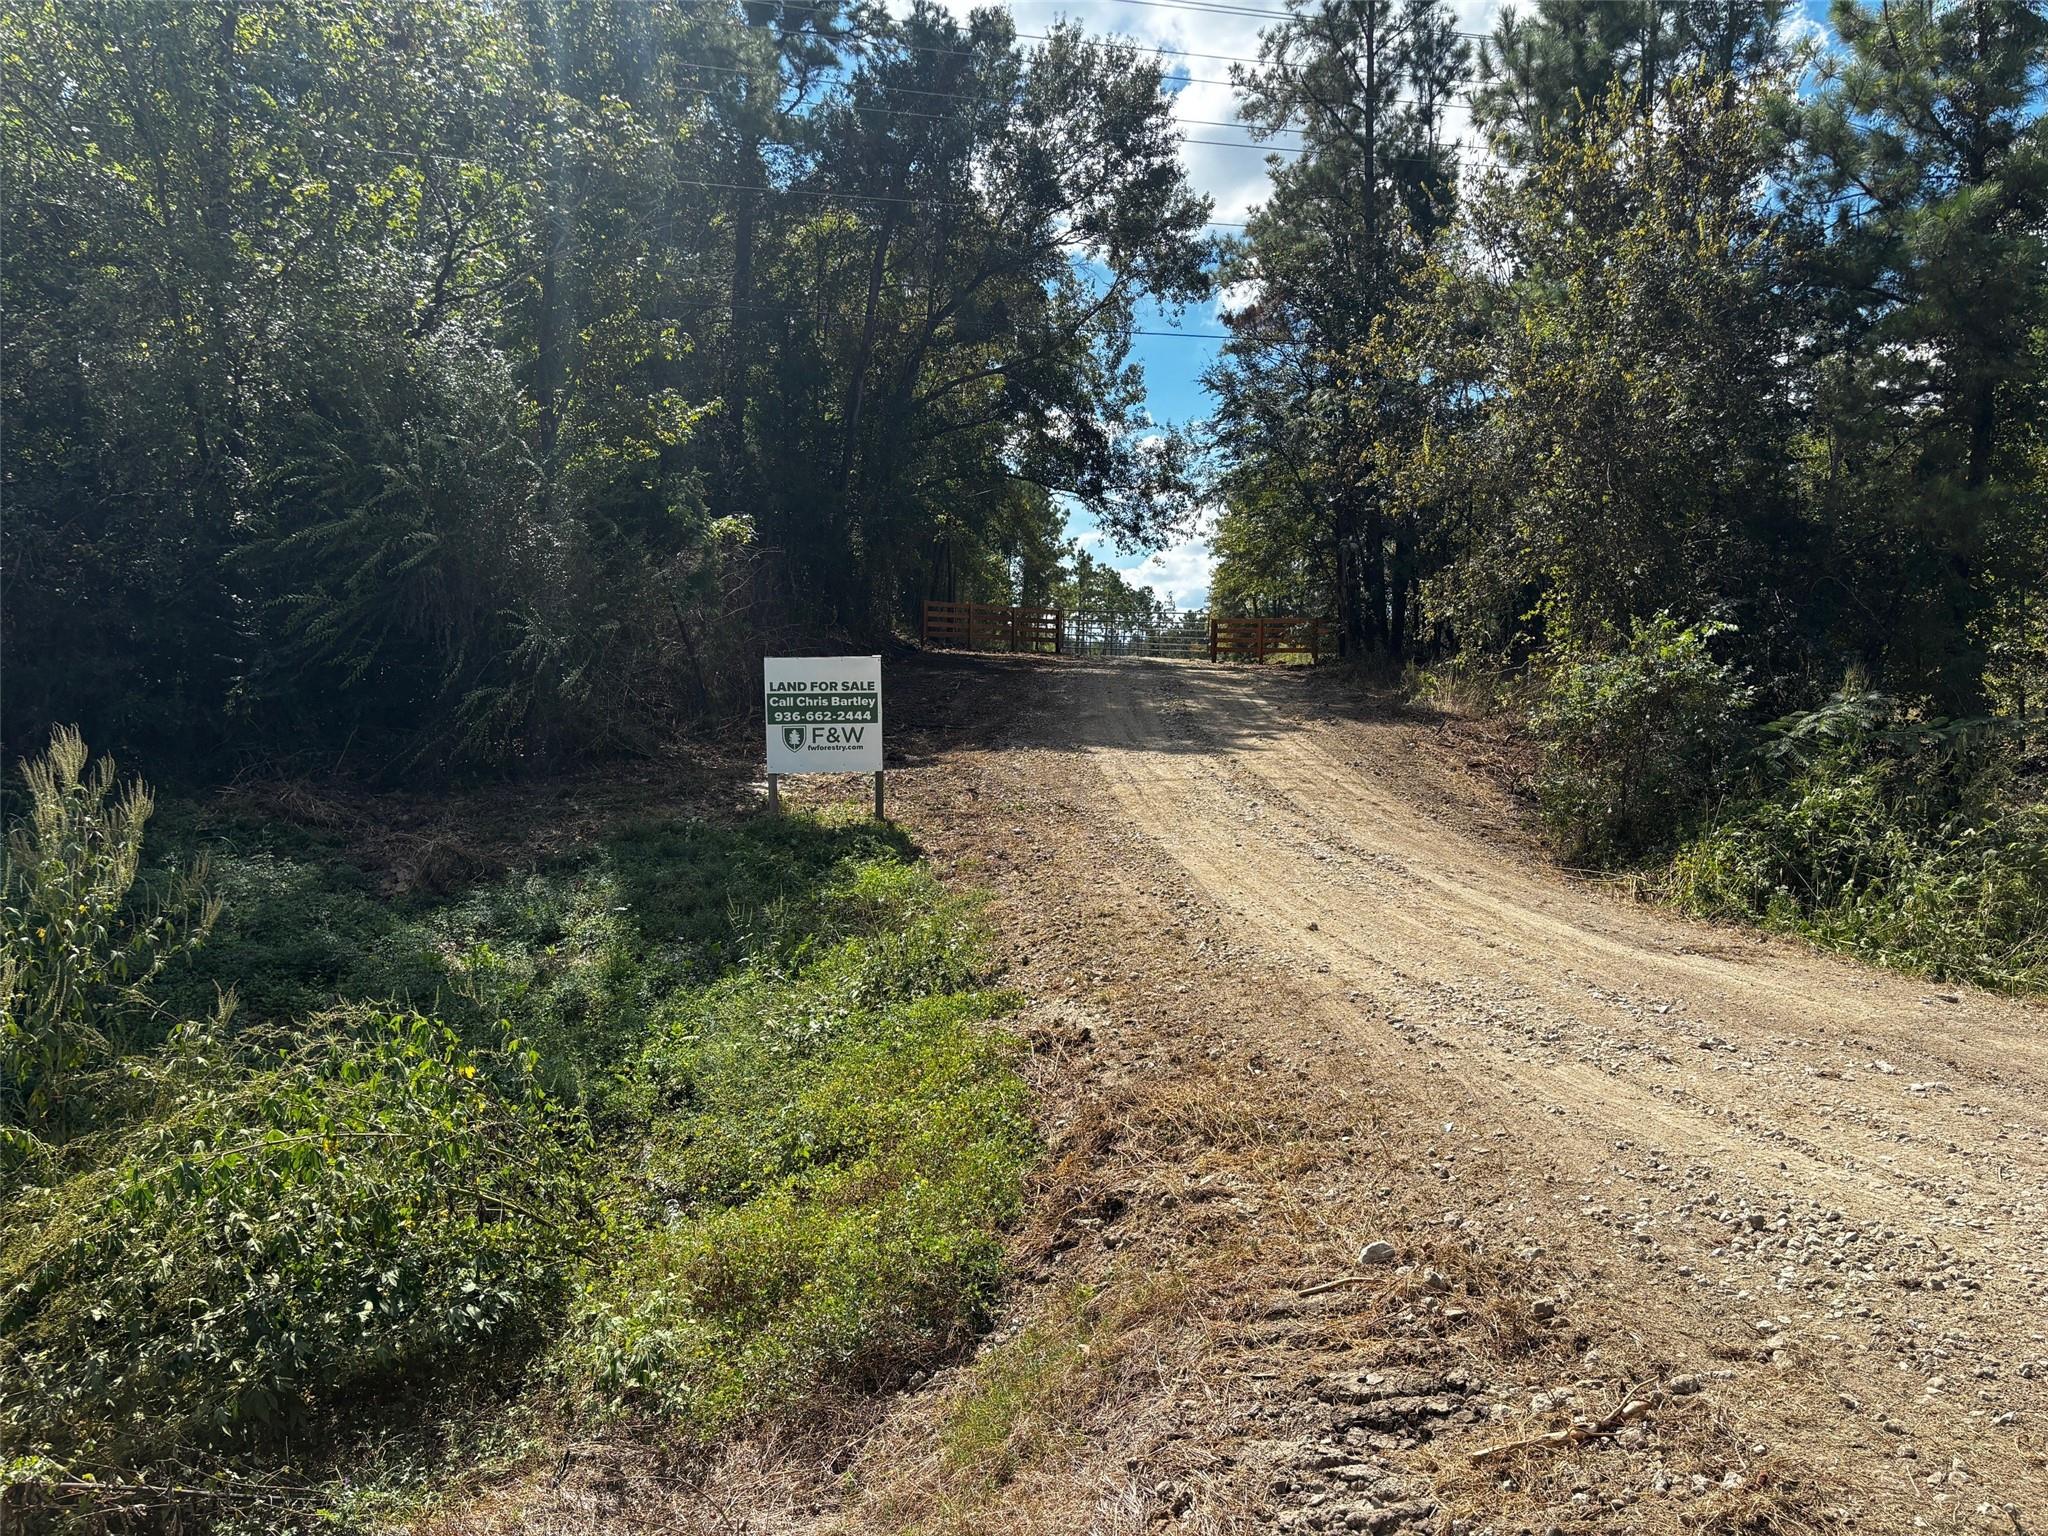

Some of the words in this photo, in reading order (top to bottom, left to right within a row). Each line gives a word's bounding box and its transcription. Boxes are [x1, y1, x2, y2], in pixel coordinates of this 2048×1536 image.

[769, 682, 807, 692] LAND
[810, 681, 838, 691] FOR
[841, 681, 875, 691] SALE
[769, 697, 794, 706] Call
[796, 696, 829, 706] Chris
[831, 696, 876, 708] Bartley
[774, 711, 871, 721] 936-662-2444
[812, 727, 864, 743] F&W
